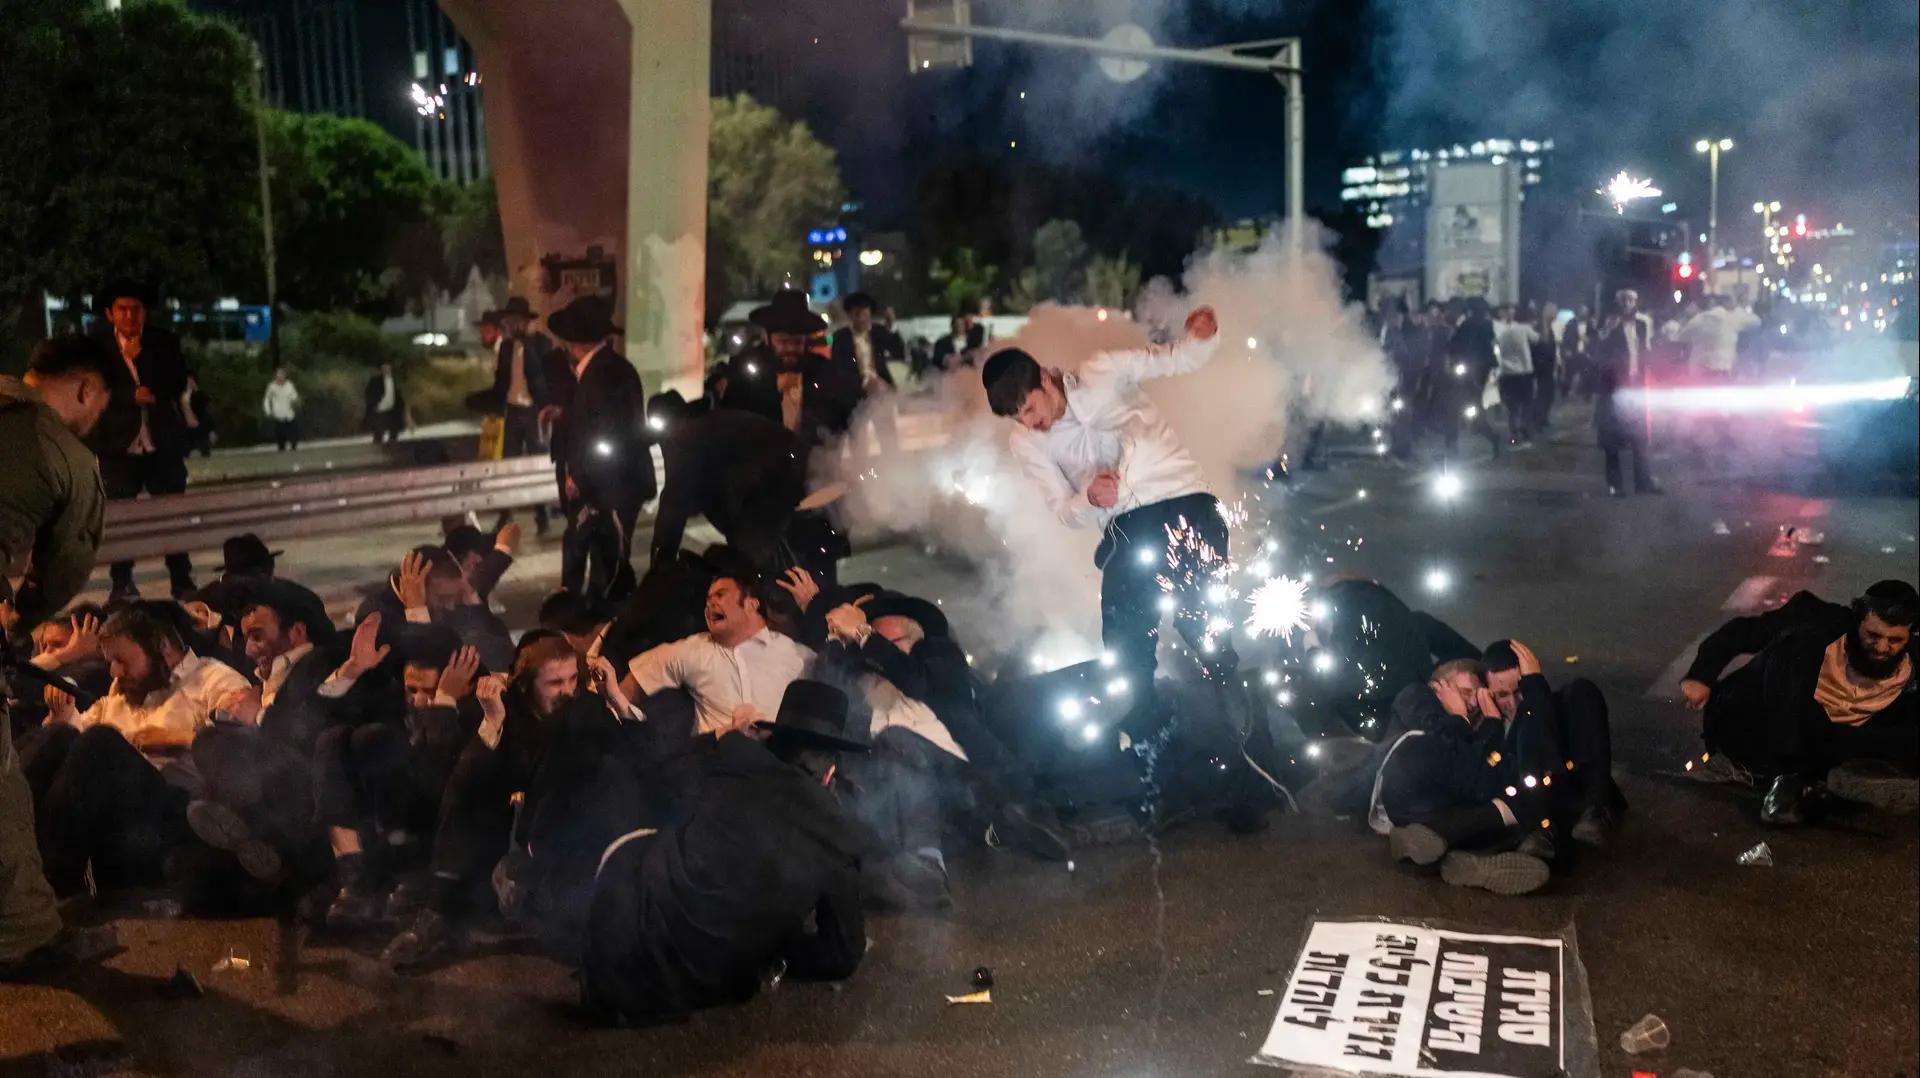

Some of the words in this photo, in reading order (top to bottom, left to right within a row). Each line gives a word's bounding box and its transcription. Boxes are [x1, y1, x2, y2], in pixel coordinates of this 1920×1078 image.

[1283, 951, 1349, 1030] ליהדות
[1343, 989, 1405, 1061] גזירת
[1427, 952, 1489, 1054] הישיבות
[1498, 967, 1550, 1047] סגירת
